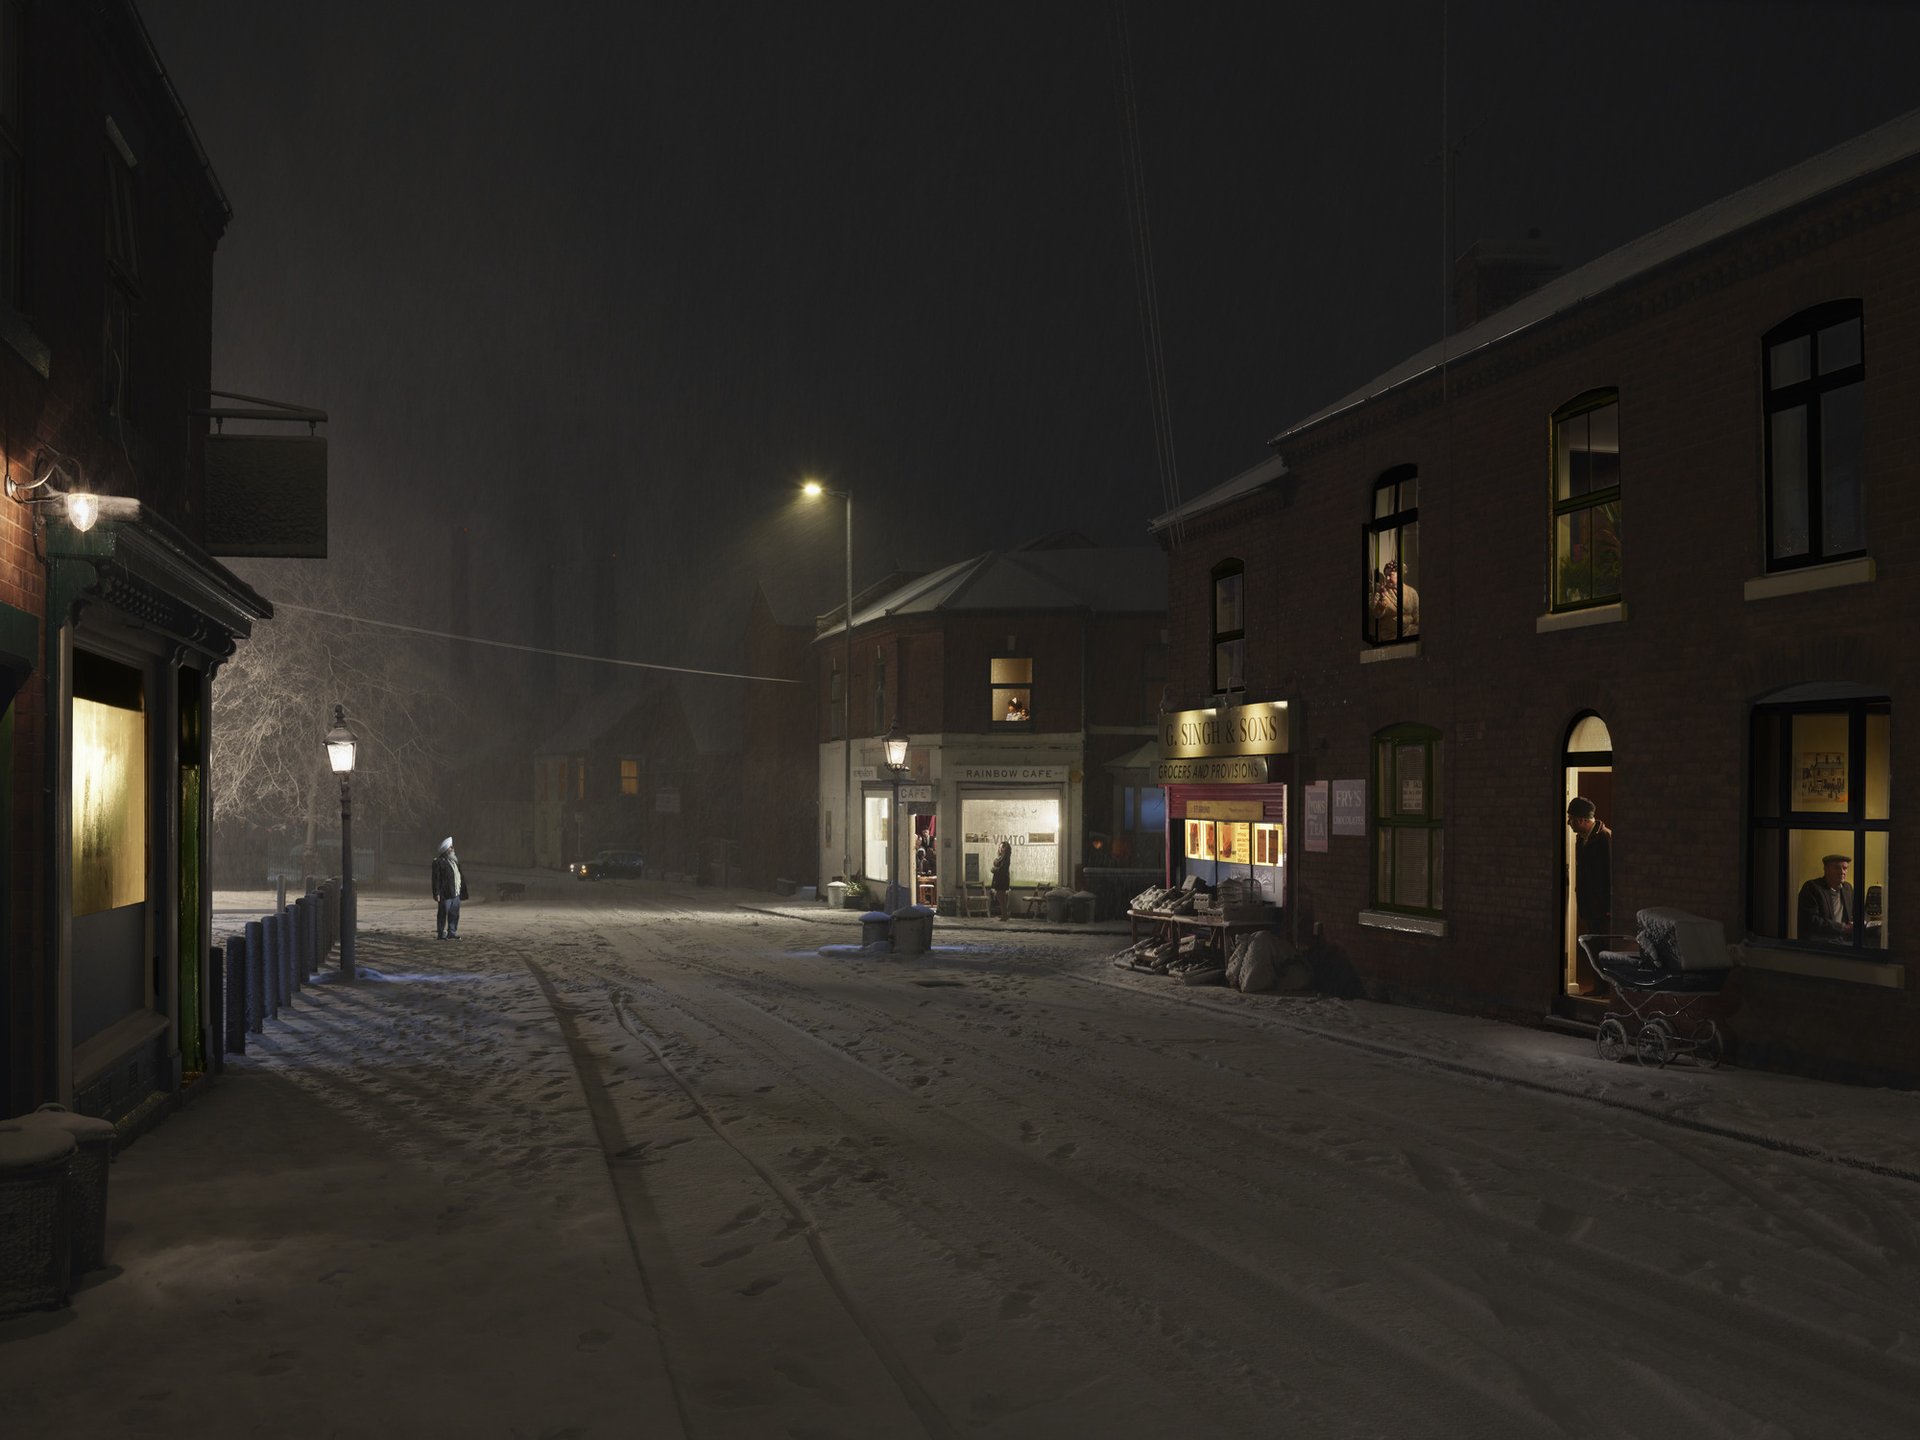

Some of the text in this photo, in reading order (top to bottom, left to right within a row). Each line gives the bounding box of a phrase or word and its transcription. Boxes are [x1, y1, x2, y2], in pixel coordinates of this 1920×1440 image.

[1166, 715, 1277, 746] G. SINGH & SONS
[966, 769, 1052, 778] RAINBOW CAFE
[1159, 763, 1259, 780] GROCERS AND PROVISIONS
[1336, 790, 1362, 808] FRY'S
[1309, 821, 1324, 836] TEA
[993, 835, 1025, 846] VIMTO
